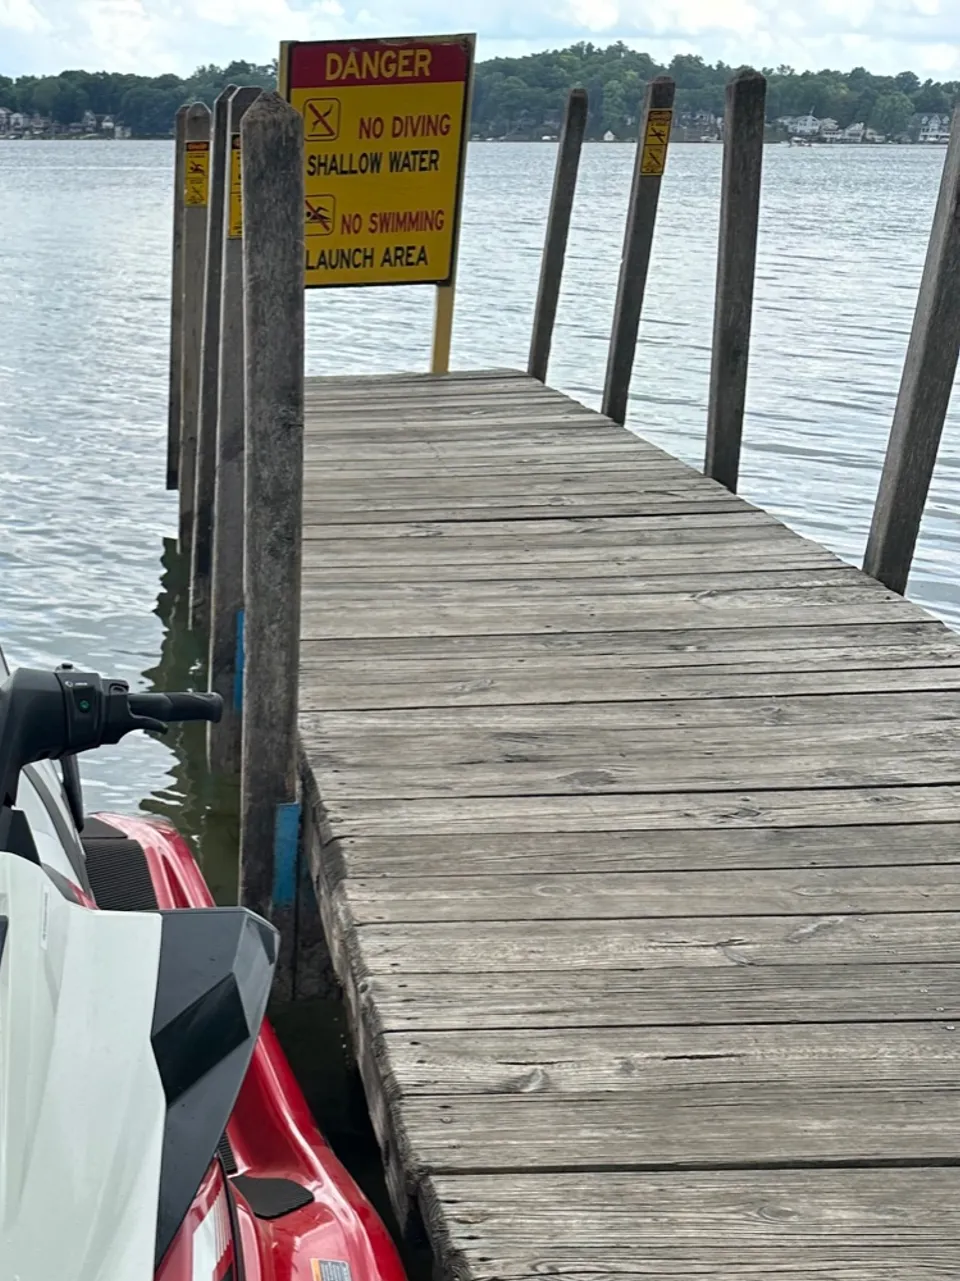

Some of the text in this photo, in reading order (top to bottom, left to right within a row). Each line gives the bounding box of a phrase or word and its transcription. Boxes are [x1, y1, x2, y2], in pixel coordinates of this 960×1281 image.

[325, 48, 432, 81] DANGER
[358, 113, 452, 140] NO DIVING
[306, 149, 440, 176] SHALLOW WATER
[340, 209, 445, 235] NO SWIMMING
[305, 245, 429, 270] LAUNCH AREA
